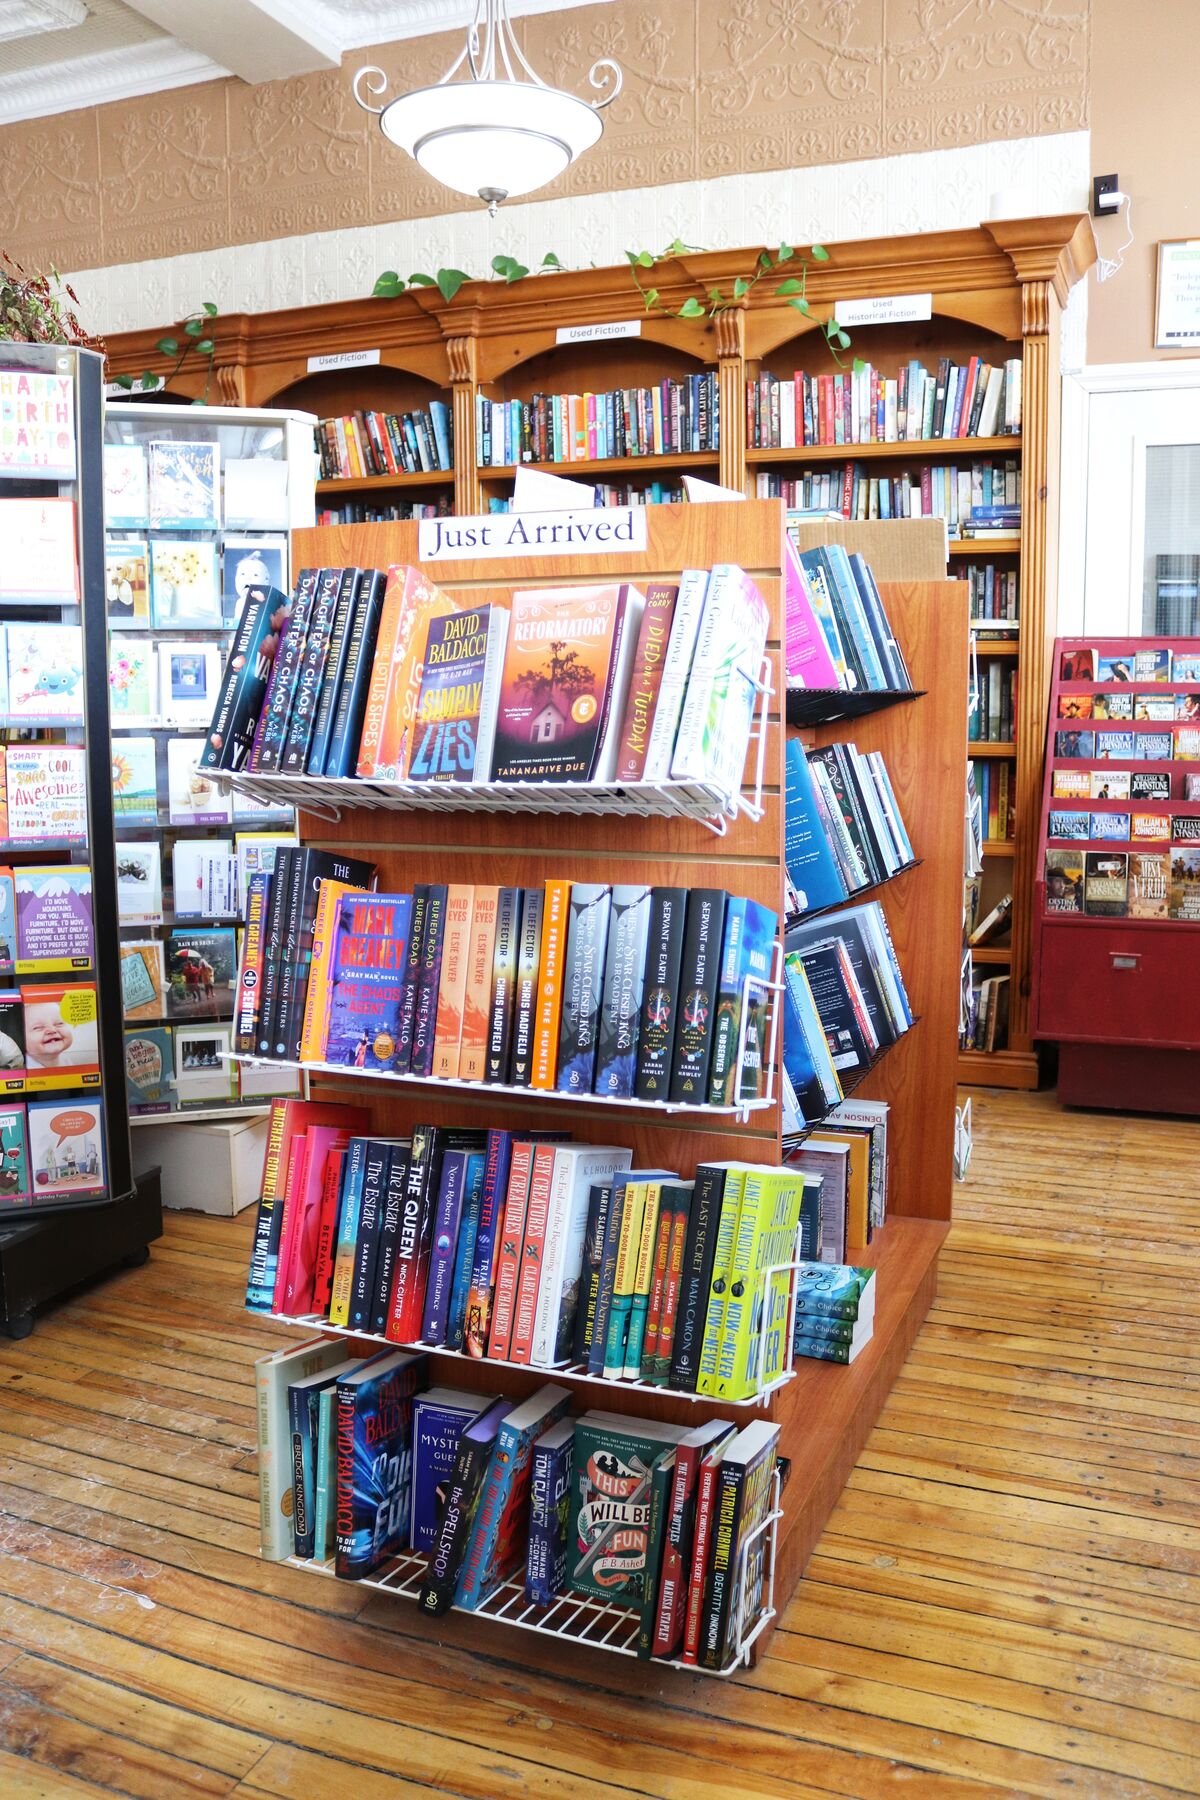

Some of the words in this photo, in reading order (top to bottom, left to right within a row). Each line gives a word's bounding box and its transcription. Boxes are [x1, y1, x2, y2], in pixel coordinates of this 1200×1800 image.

[847, 311, 887, 321] Historical
[888, 310, 917, 319] Fiction
[872, 300, 893, 308] Used
[569, 328, 593, 338] Used
[594, 325, 626, 335] Fiction
[319, 356, 338, 365] Used
[339, 352, 367, 362] Fiction
[845, 465, 854, 493] ATOMIC
[427, 521, 492, 557] Just
[505, 510, 636, 545] Arrived
[443, 614, 480, 641] DAVID
[514, 616, 610, 641] REFORMATORY
[428, 633, 488, 665] BALDACCI
[422, 681, 482, 721] SIMPLY
[13, 752, 43, 760] SMART
[409, 720, 476, 774] LIES
[1099, 741, 1133, 750] JOHNSTONE
[1136, 742, 1170, 751] JOHNSTONE
[48, 760, 72, 773] COOL
[497, 764, 562, 776] TANANARIVE
[565, 762, 586, 772] DUE
[1134, 774, 1156, 782] WILLIAM
[1132, 781, 1169, 791] JOHNSTONE
[1091, 823, 1128, 834] JOHNSTONE
[1133, 827, 1169, 836] JOHNSTONE
[1134, 818, 1158, 827] WILLIAM
[333, 863, 350, 879] THE
[1140, 861, 1161, 878] MESA
[54, 897, 69, 905] MOVE
[1133, 875, 1167, 899] VERDE
[249, 894, 262, 921] MARK
[414, 898, 424, 933] BURIED
[429, 900, 440, 935] BURIED
[448, 910, 468, 922] EYES
[449, 898, 468, 910] WILD
[475, 911, 494, 924] EYES
[476, 900, 495, 911] WILD
[551, 888, 561, 923] TANA
[1048, 898, 1077, 907] DESTINY
[1055, 904, 1080, 912] EAGLES
[352, 904, 396, 936] MARK
[25, 935, 52, 943] EVERYONE
[246, 923, 260, 968] GREANEY
[339, 936, 405, 970] GREANEY
[410, 936, 420, 966] ROAD
[425, 939, 436, 969] ROAD
[546, 928, 558, 977] FRENCH
[346, 1001, 386, 1016] AGENT
[404, 984, 415, 1011] KATIE
[420, 987, 431, 1014] KATIE
[543, 1001, 552, 1024] THE
[239, 991, 256, 1035] SENTINEL
[720, 1017, 730, 1031] THE
[401, 1012, 411, 1045] TALLO
[416, 1015, 427, 1048] TALLO
[538, 1030, 550, 1080] HUNTER
[714, 1032, 728, 1073] OBSERVER
[269, 1107, 286, 1154] MICHAEL
[367, 1161, 383, 1187] The
[390, 1164, 406, 1189] The
[485, 1135, 500, 1193] DANIELLE
[512, 1151, 530, 1172] SHY
[535, 1153, 552, 1175] SHY
[261, 1155, 280, 1210] CONNELLY
[407, 1165, 424, 1197] THE
[703, 1180, 713, 1200] The
[726, 1175, 741, 1208] JANET
[743, 1176, 761, 1210] JANET
[362, 1188, 380, 1229] Estate
[384, 1192, 403, 1233] Estate
[480, 1194, 493, 1229] STEEL
[505, 1174, 527, 1236] CREATURES
[527, 1175, 549, 1239] CREATURES
[600, 1189, 609, 1212] KARIN
[699, 1200, 710, 1229] LAST
[770, 1190, 796, 1227] JANET
[258, 1216, 273, 1236] THE
[399, 1199, 419, 1260] QUEEN
[593, 1213, 607, 1260] SLAUGHTER
[715, 1212, 737, 1269] EVANOVICH
[316, 1224, 329, 1280] BETRAYAL
[693, 1229, 705, 1273] SECRET
[734, 1213, 756, 1272] EVANOVICH
[251, 1236, 269, 1286] WAITING
[359, 1243, 369, 1274] SARAH
[383, 1247, 392, 1278] SARAH
[357, 1275, 365, 1300] JOST
[399, 1263, 408, 1286] NICK
[432, 1259, 447, 1310] Inheritance
[500, 1262, 515, 1292] CLARE
[522, 1265, 537, 1295] CLARE
[591, 1273, 600, 1297] AFTER
[380, 1279, 388, 1303] JOST
[393, 1286, 406, 1319] CUTTER
[689, 1278, 700, 1307] MAIA
[494, 1292, 513, 1338] CHAMBERS
[516, 1295, 534, 1341] CHAMBERS
[587, 1297, 597, 1319] THAT
[706, 1298, 724, 1330] NOW
[725, 1302, 744, 1333] NOW
[817, 1302, 843, 1313] Choice
[583, 1319, 594, 1346] NIGHT
[681, 1307, 696, 1351] CARON
[709, 1329, 718, 1338] OR
[727, 1332, 736, 1341] OR
[815, 1323, 840, 1335] Choice
[700, 1337, 720, 1376] NEVER
[717, 1340, 738, 1379] NEVER
[810, 1344, 835, 1355] Choice
[337, 1404, 355, 1452] DAVID
[443, 1427, 457, 1435] THE
[294, 1444, 303, 1480] BRIDGE
[534, 1454, 548, 1478] TOM
[336, 1453, 355, 1537] BALDACCI
[450, 1486, 463, 1504] the
[594, 1467, 628, 1496] THIS
[296, 1483, 305, 1533] KINGDOM
[531, 1479, 546, 1527] CLANCY
[590, 1503, 629, 1522] WILL
[720, 1485, 737, 1525] PATRICIA
[434, 1504, 461, 1578] SPELLSHOP
[613, 1533, 643, 1550] FUN
[713, 1525, 732, 1571] CORNWELL
[538, 1540, 548, 1578] COMMAND
[712, 1573, 724, 1611] IDENTITY
[707, 1611, 721, 1650] UNKNOWN
